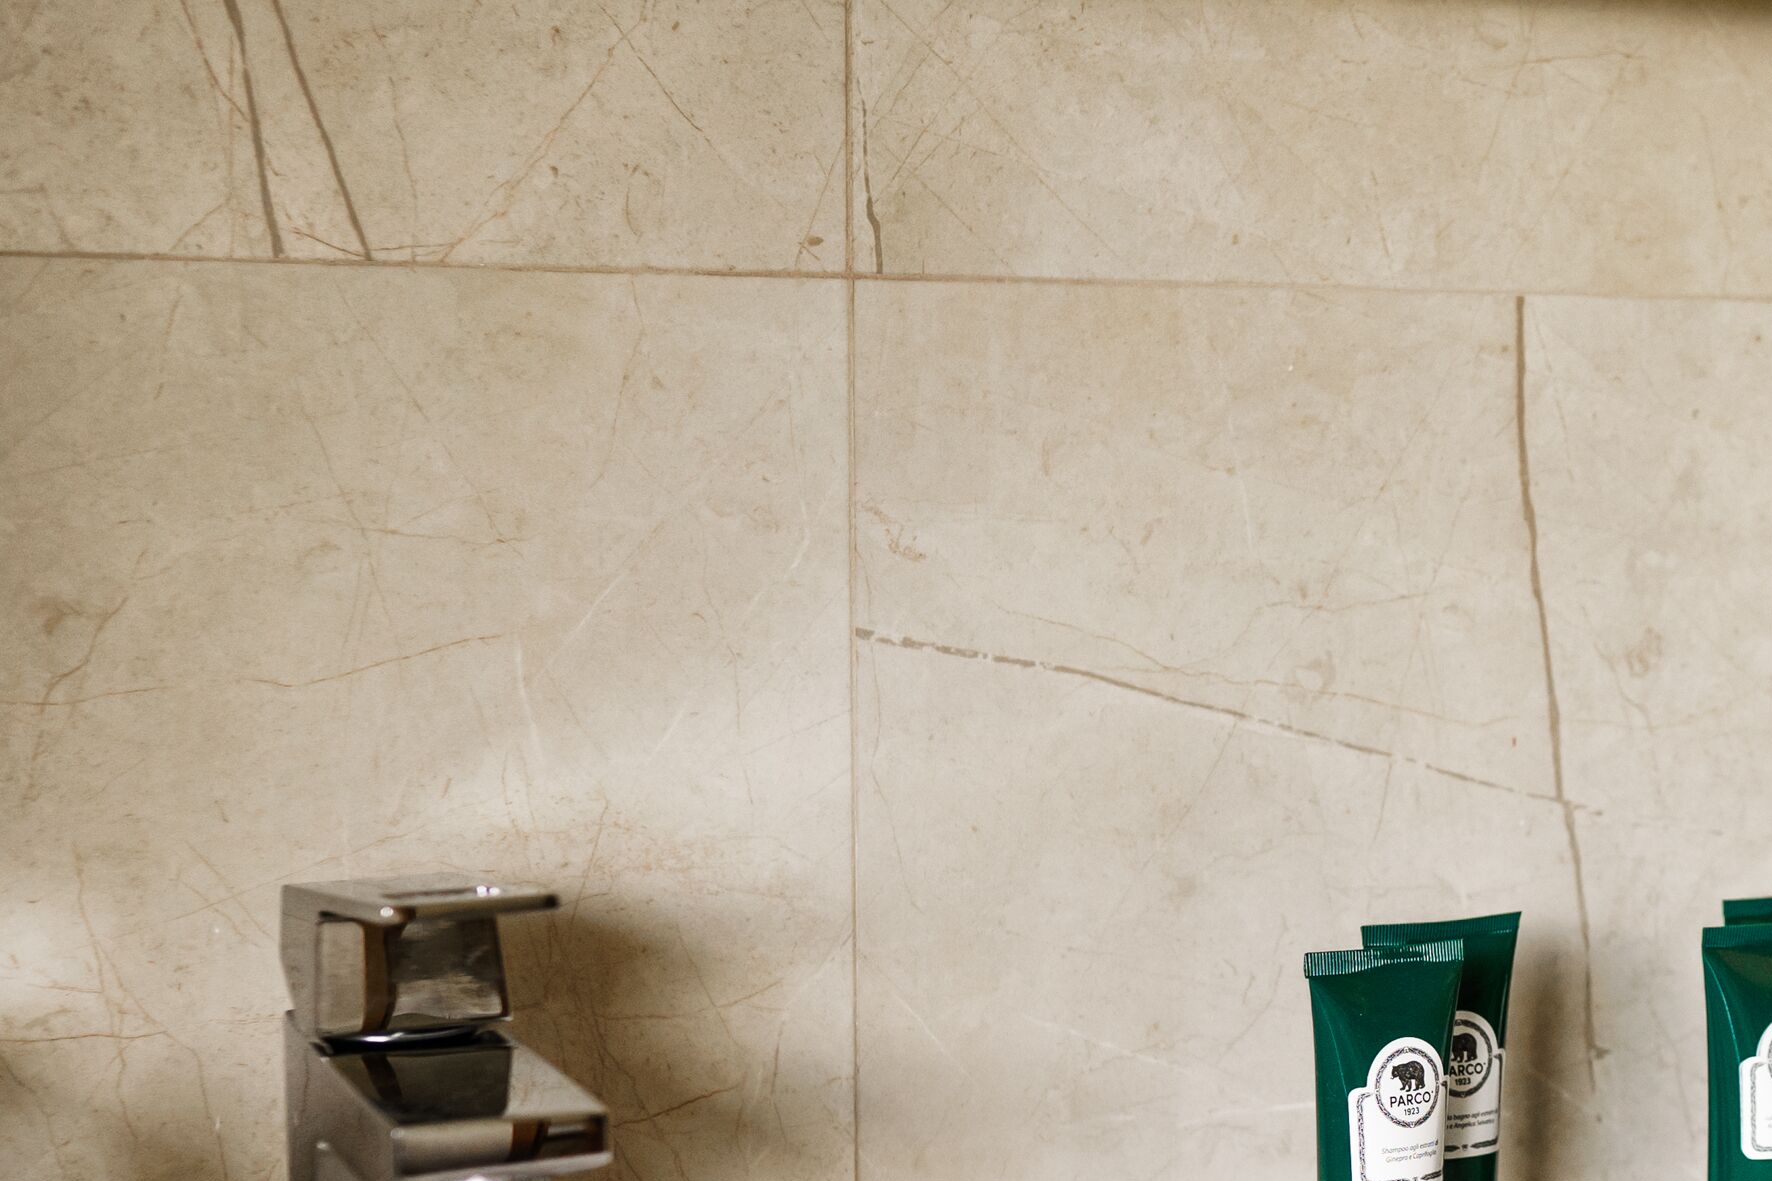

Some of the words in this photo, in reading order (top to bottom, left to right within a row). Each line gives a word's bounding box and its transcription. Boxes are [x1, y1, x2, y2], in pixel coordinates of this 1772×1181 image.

[1448, 1062, 1484, 1077] ARCO
[1390, 1091, 1431, 1108] PARCO
[1404, 1107, 1420, 1116] 1923
